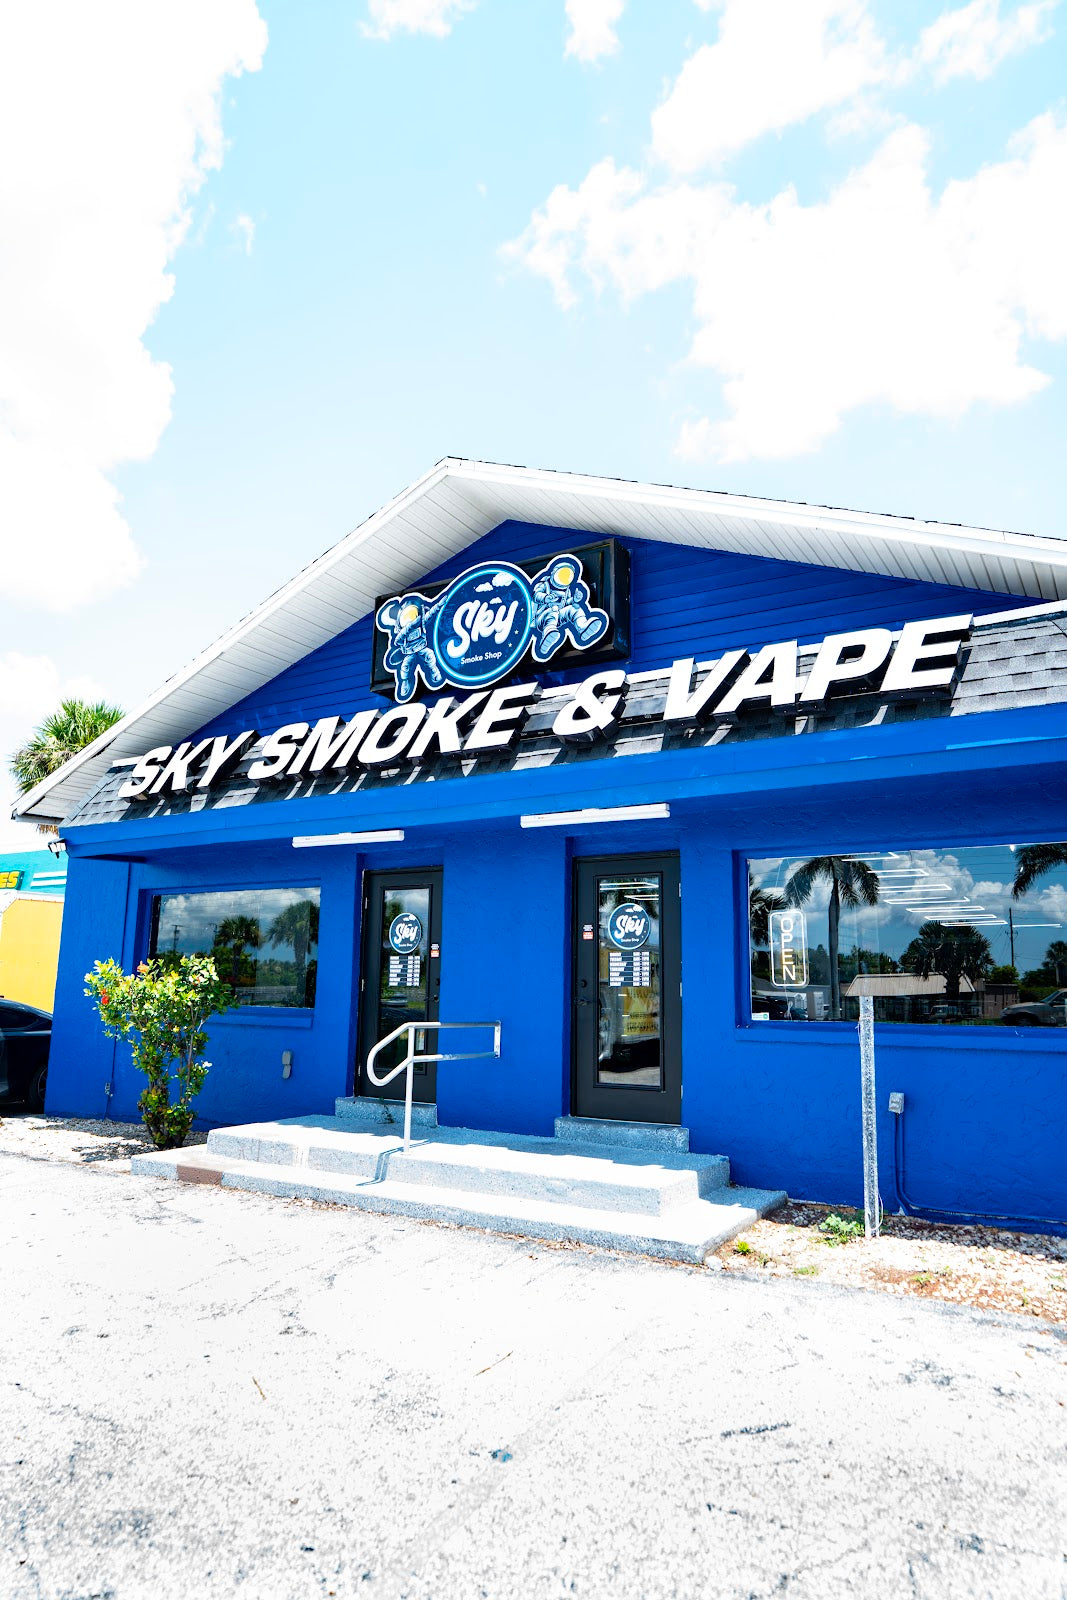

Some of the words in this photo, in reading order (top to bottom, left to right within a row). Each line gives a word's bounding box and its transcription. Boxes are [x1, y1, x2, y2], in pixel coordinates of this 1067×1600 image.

[446, 600, 519, 658] Sky
[461, 655, 483, 665] Smoke
[484, 651, 503, 660] Shop
[117, 730, 256, 798] SKY
[247, 682, 540, 780] SMOKE
[552, 669, 627, 735] &
[662, 613, 974, 721] VAPE
[393, 923, 418, 944] Sky
[614, 914, 646, 939] Sky
[780, 917, 796, 981] OPEN
